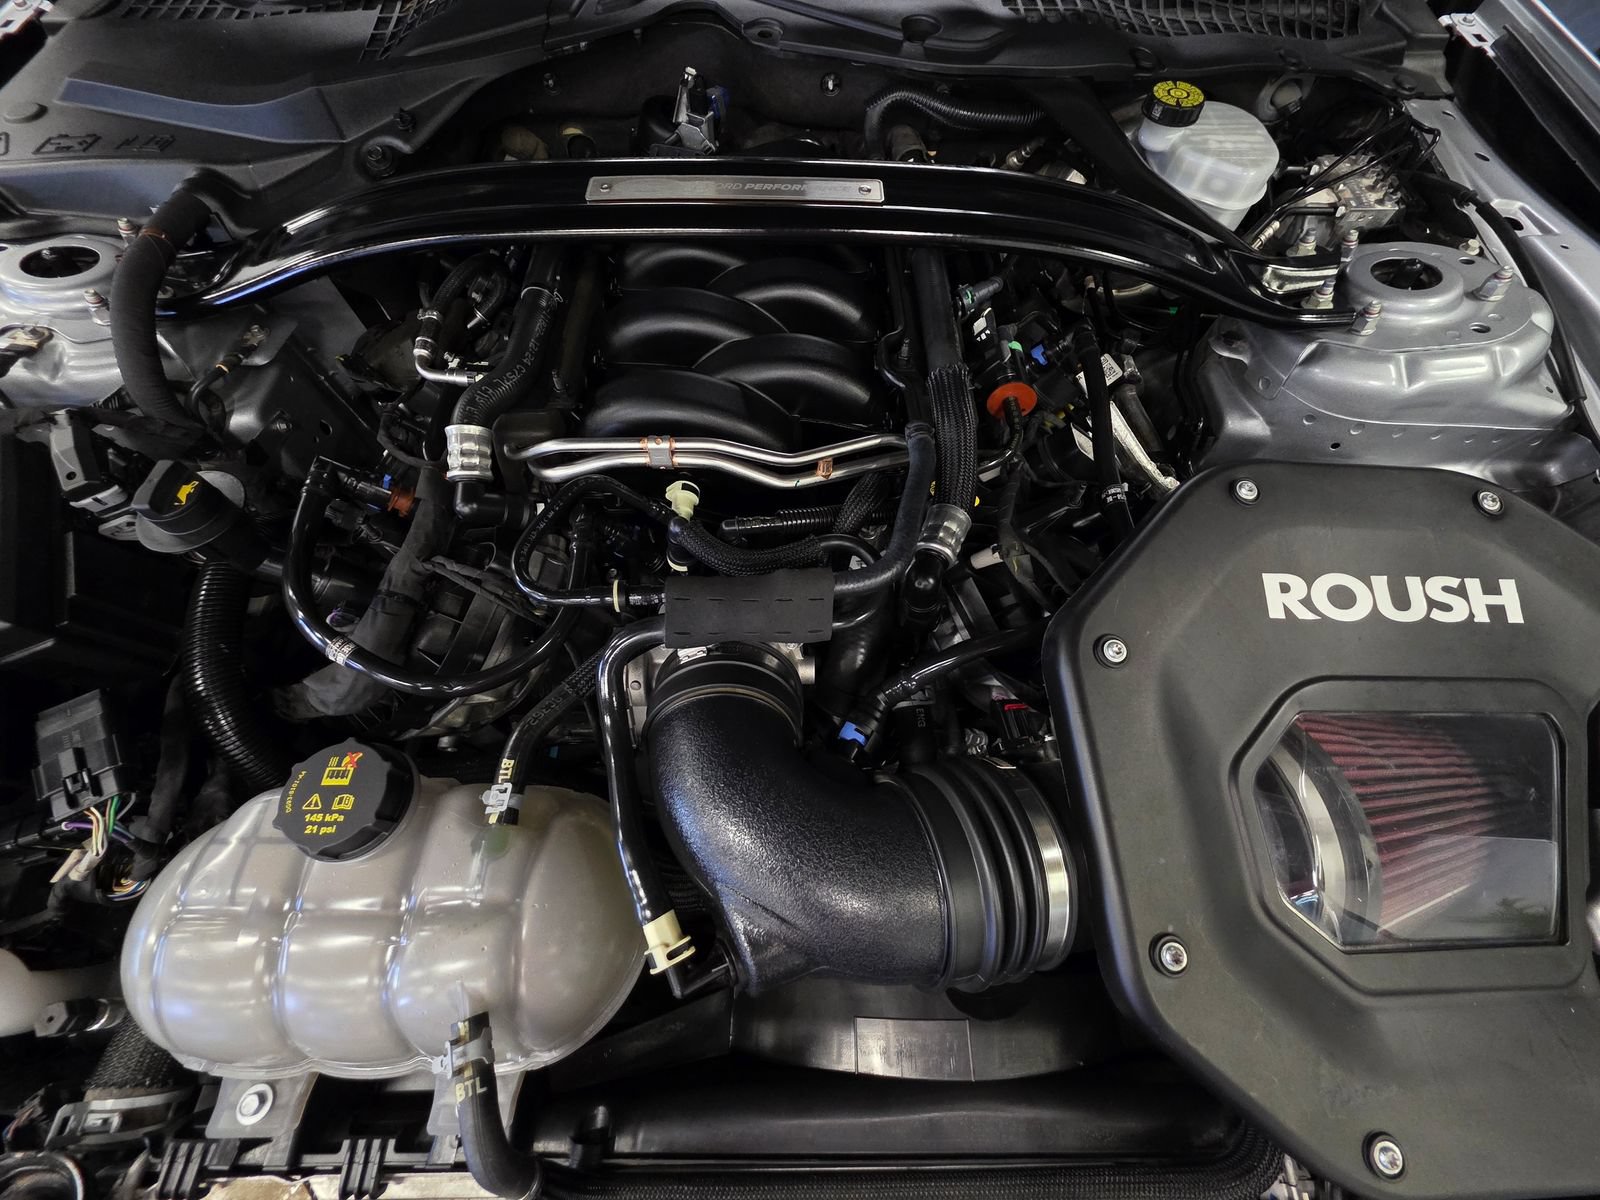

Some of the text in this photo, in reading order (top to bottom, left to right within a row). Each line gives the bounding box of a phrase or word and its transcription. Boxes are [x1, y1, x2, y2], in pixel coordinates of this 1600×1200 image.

[744, 183, 822, 193] PERFOR
[1261, 572, 1525, 624] ROUSH
[498, 758, 515, 784] BTL
[304, 813, 344, 822] 145 kPa
[304, 825, 336, 835] 21 psi
[455, 1077, 487, 1104] BTL
